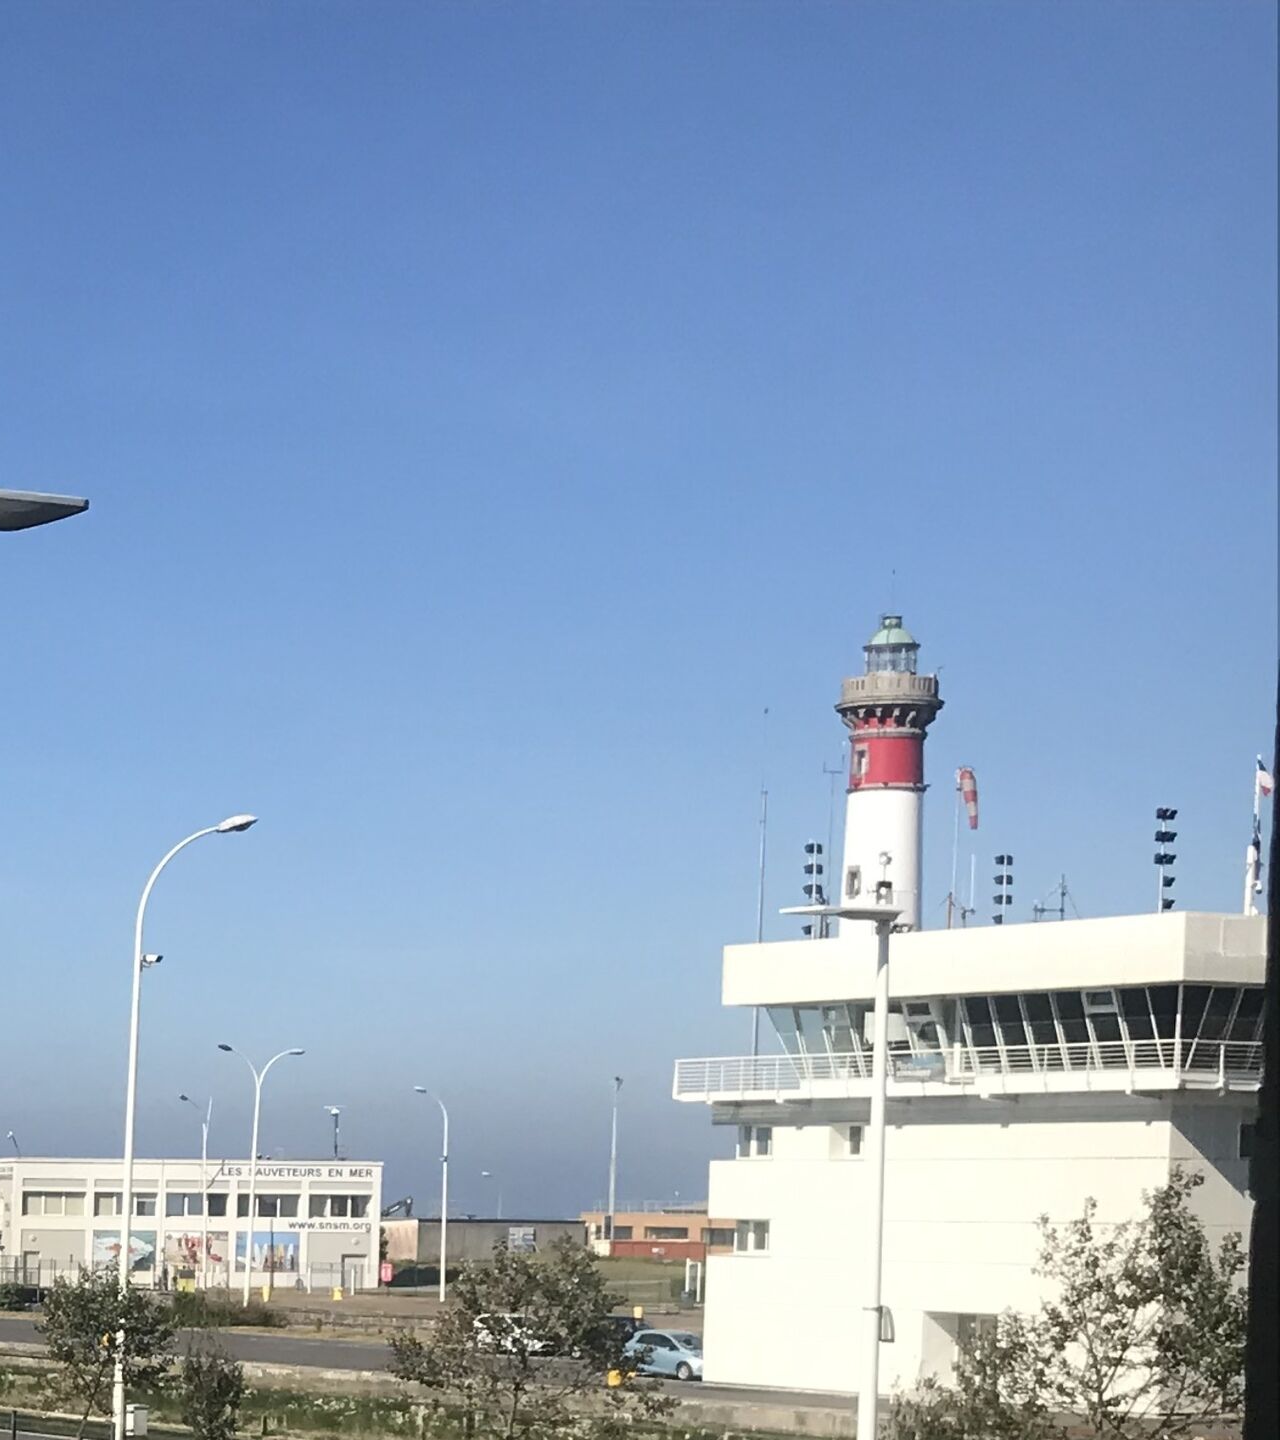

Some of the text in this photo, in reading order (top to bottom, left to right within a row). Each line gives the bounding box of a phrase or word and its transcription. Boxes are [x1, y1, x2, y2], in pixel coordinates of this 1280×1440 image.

[221, 1167, 373, 1177] LES AUVETEURS EN MER
[288, 1221, 371, 1233] www.snsm.org
